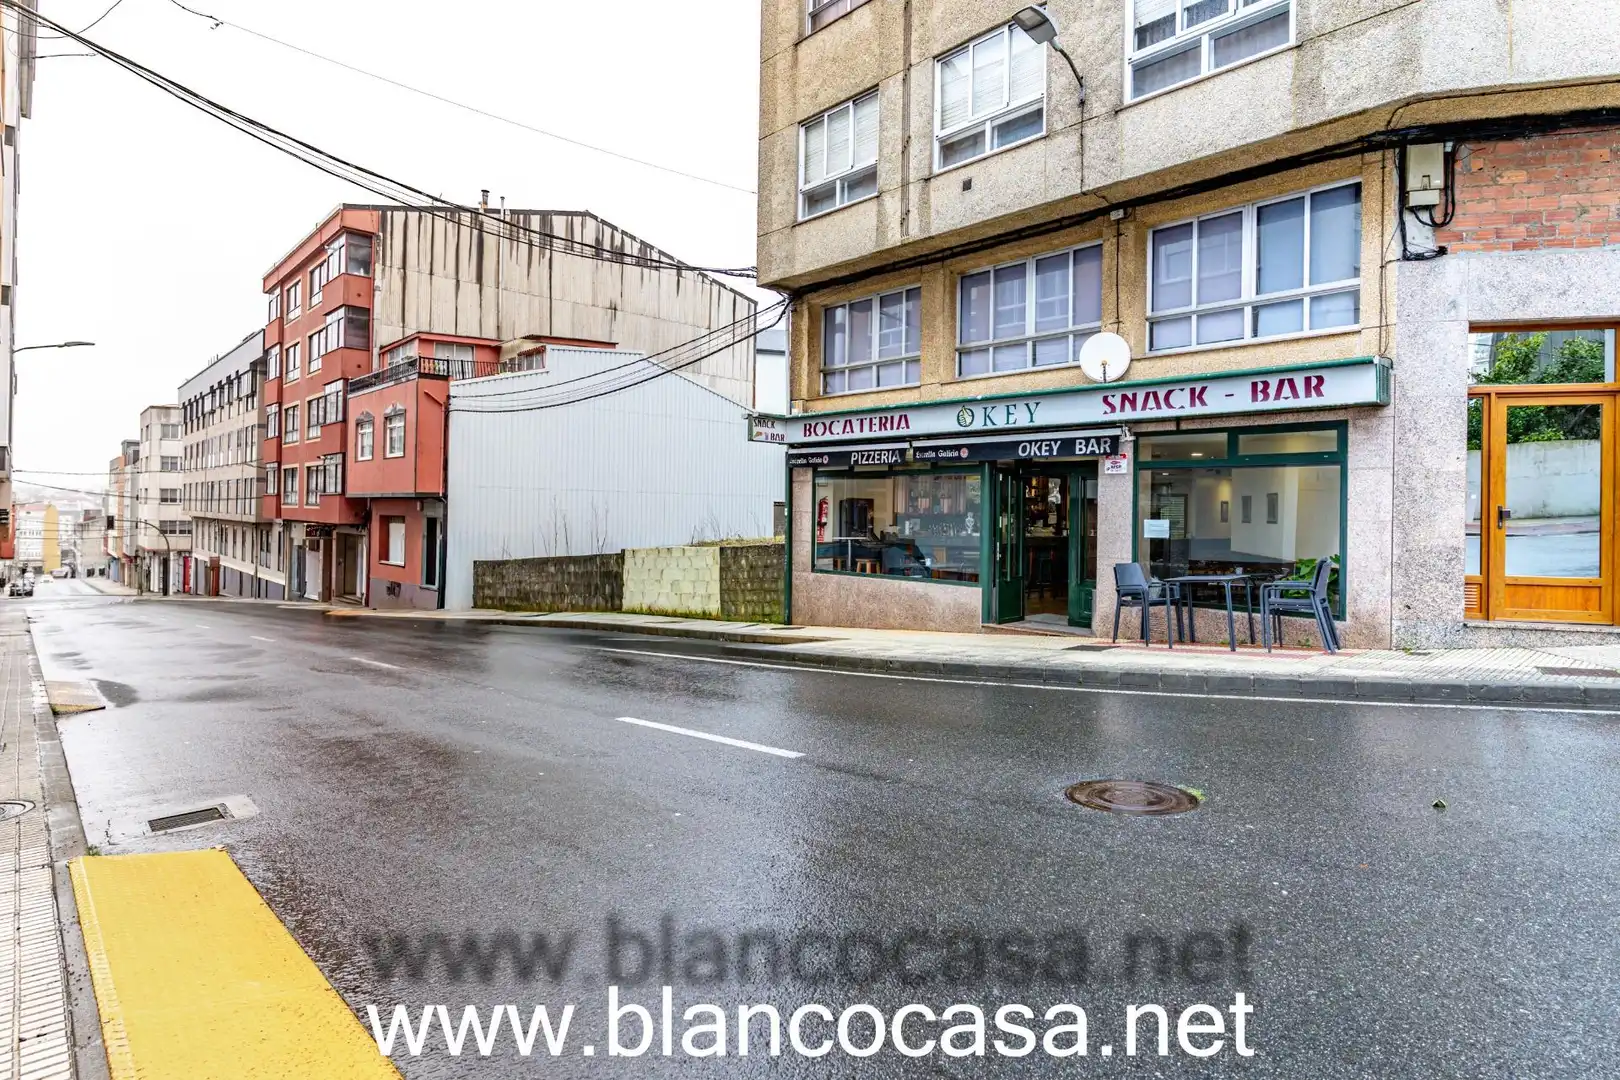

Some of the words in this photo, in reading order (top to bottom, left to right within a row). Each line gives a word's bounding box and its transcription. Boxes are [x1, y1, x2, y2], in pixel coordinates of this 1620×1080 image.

[803, 414, 910, 437] BOCATERIA
[957, 401, 1041, 428] OKEY
[1102, 385, 1209, 415] SNACK
[1250, 374, 1326, 404] BAR
[753, 418, 776, 429] SNACK
[770, 432, 785, 442] BAR
[1018, 440, 1062, 458] OKEY
[1075, 437, 1111, 455] BAR
[850, 449, 901, 466] PIZZERIA
